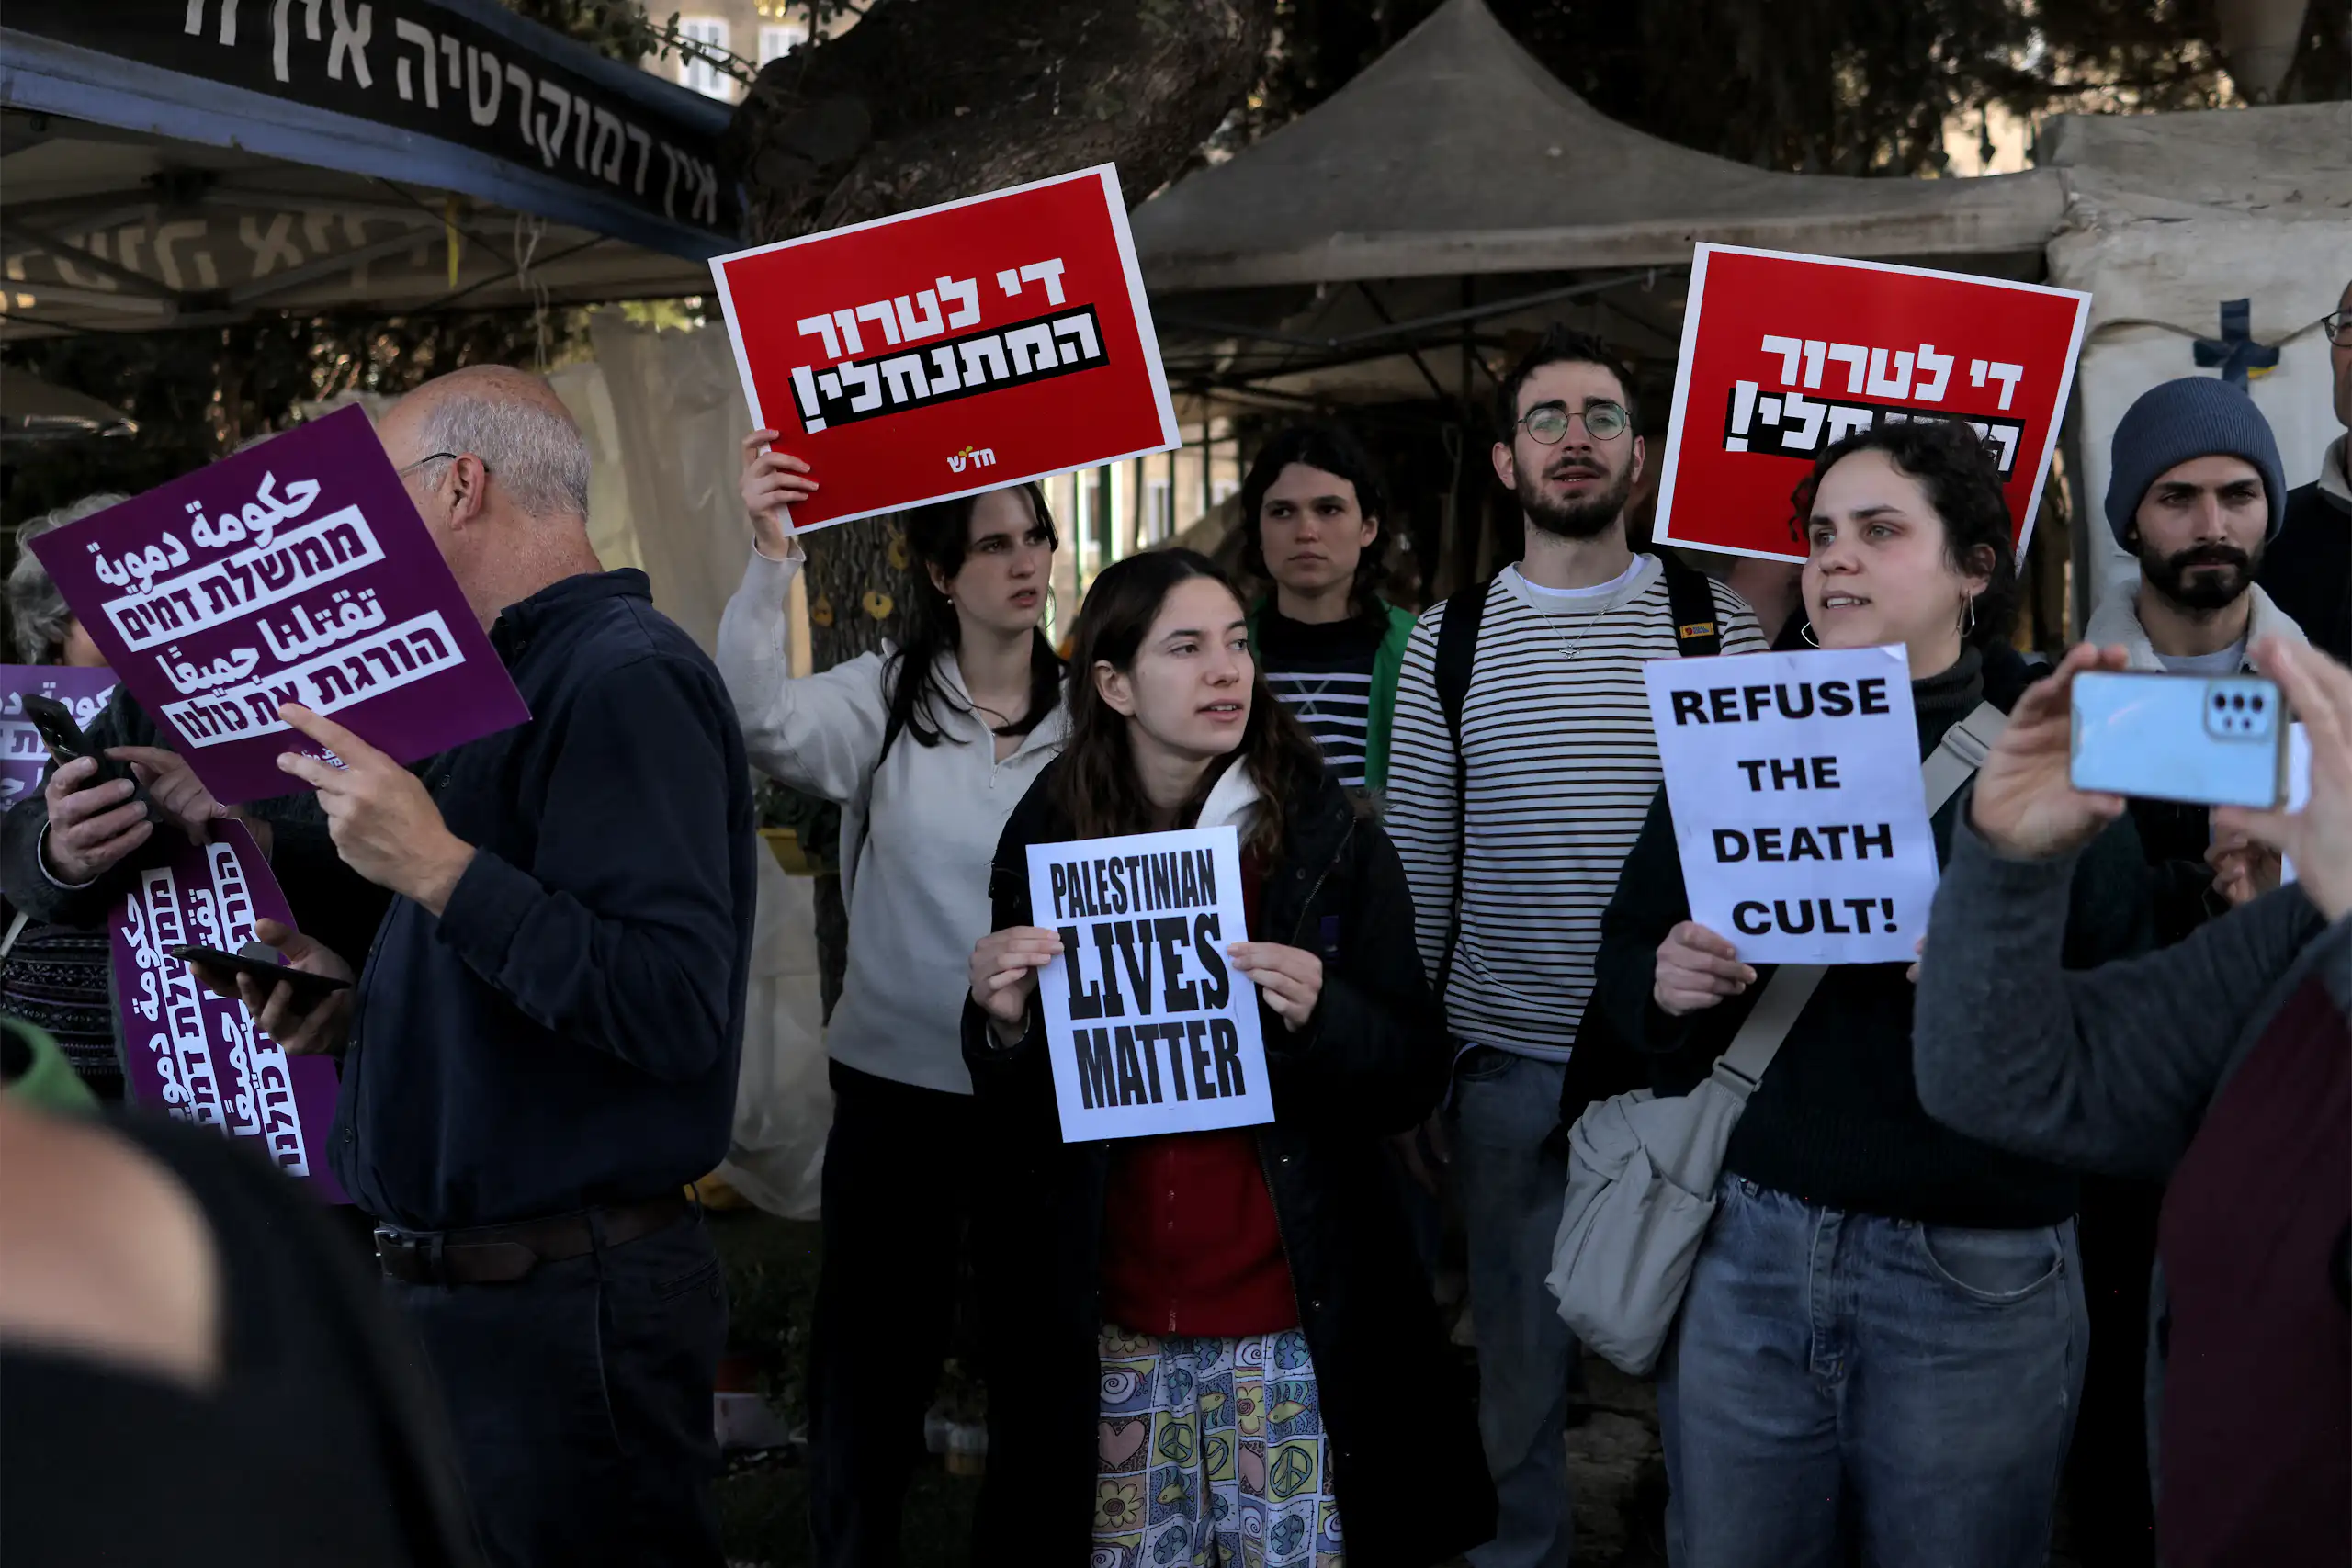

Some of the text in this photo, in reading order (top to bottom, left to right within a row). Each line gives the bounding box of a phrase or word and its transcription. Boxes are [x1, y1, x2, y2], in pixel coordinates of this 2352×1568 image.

[396, 18, 652, 195] דמוקרטיה
[662, 141, 717, 224] אין
[797, 257, 1066, 359] די לטרור
[791, 312, 1102, 434] המתנחלי!
[1760, 334, 2023, 411] די לטרור
[86, 470, 322, 595] حكومة دموية
[116, 523, 368, 641] ממשלת דמים
[256, 588, 387, 662] تقتلنا
[307, 627, 450, 705] הורגת
[1670, 676, 1890, 726] REFUSE
[172, 699, 248, 739] כולנו
[1737, 756, 1841, 792] THE
[1713, 823, 1894, 863] DEATH
[1050, 848, 1217, 919] PALESTINIAN
[1732, 897, 1897, 936] CULT!
[121, 893, 161, 1021] حكومة
[1057, 912, 1230, 1021] LIVES
[1072, 1018, 1247, 1110] MATTER
